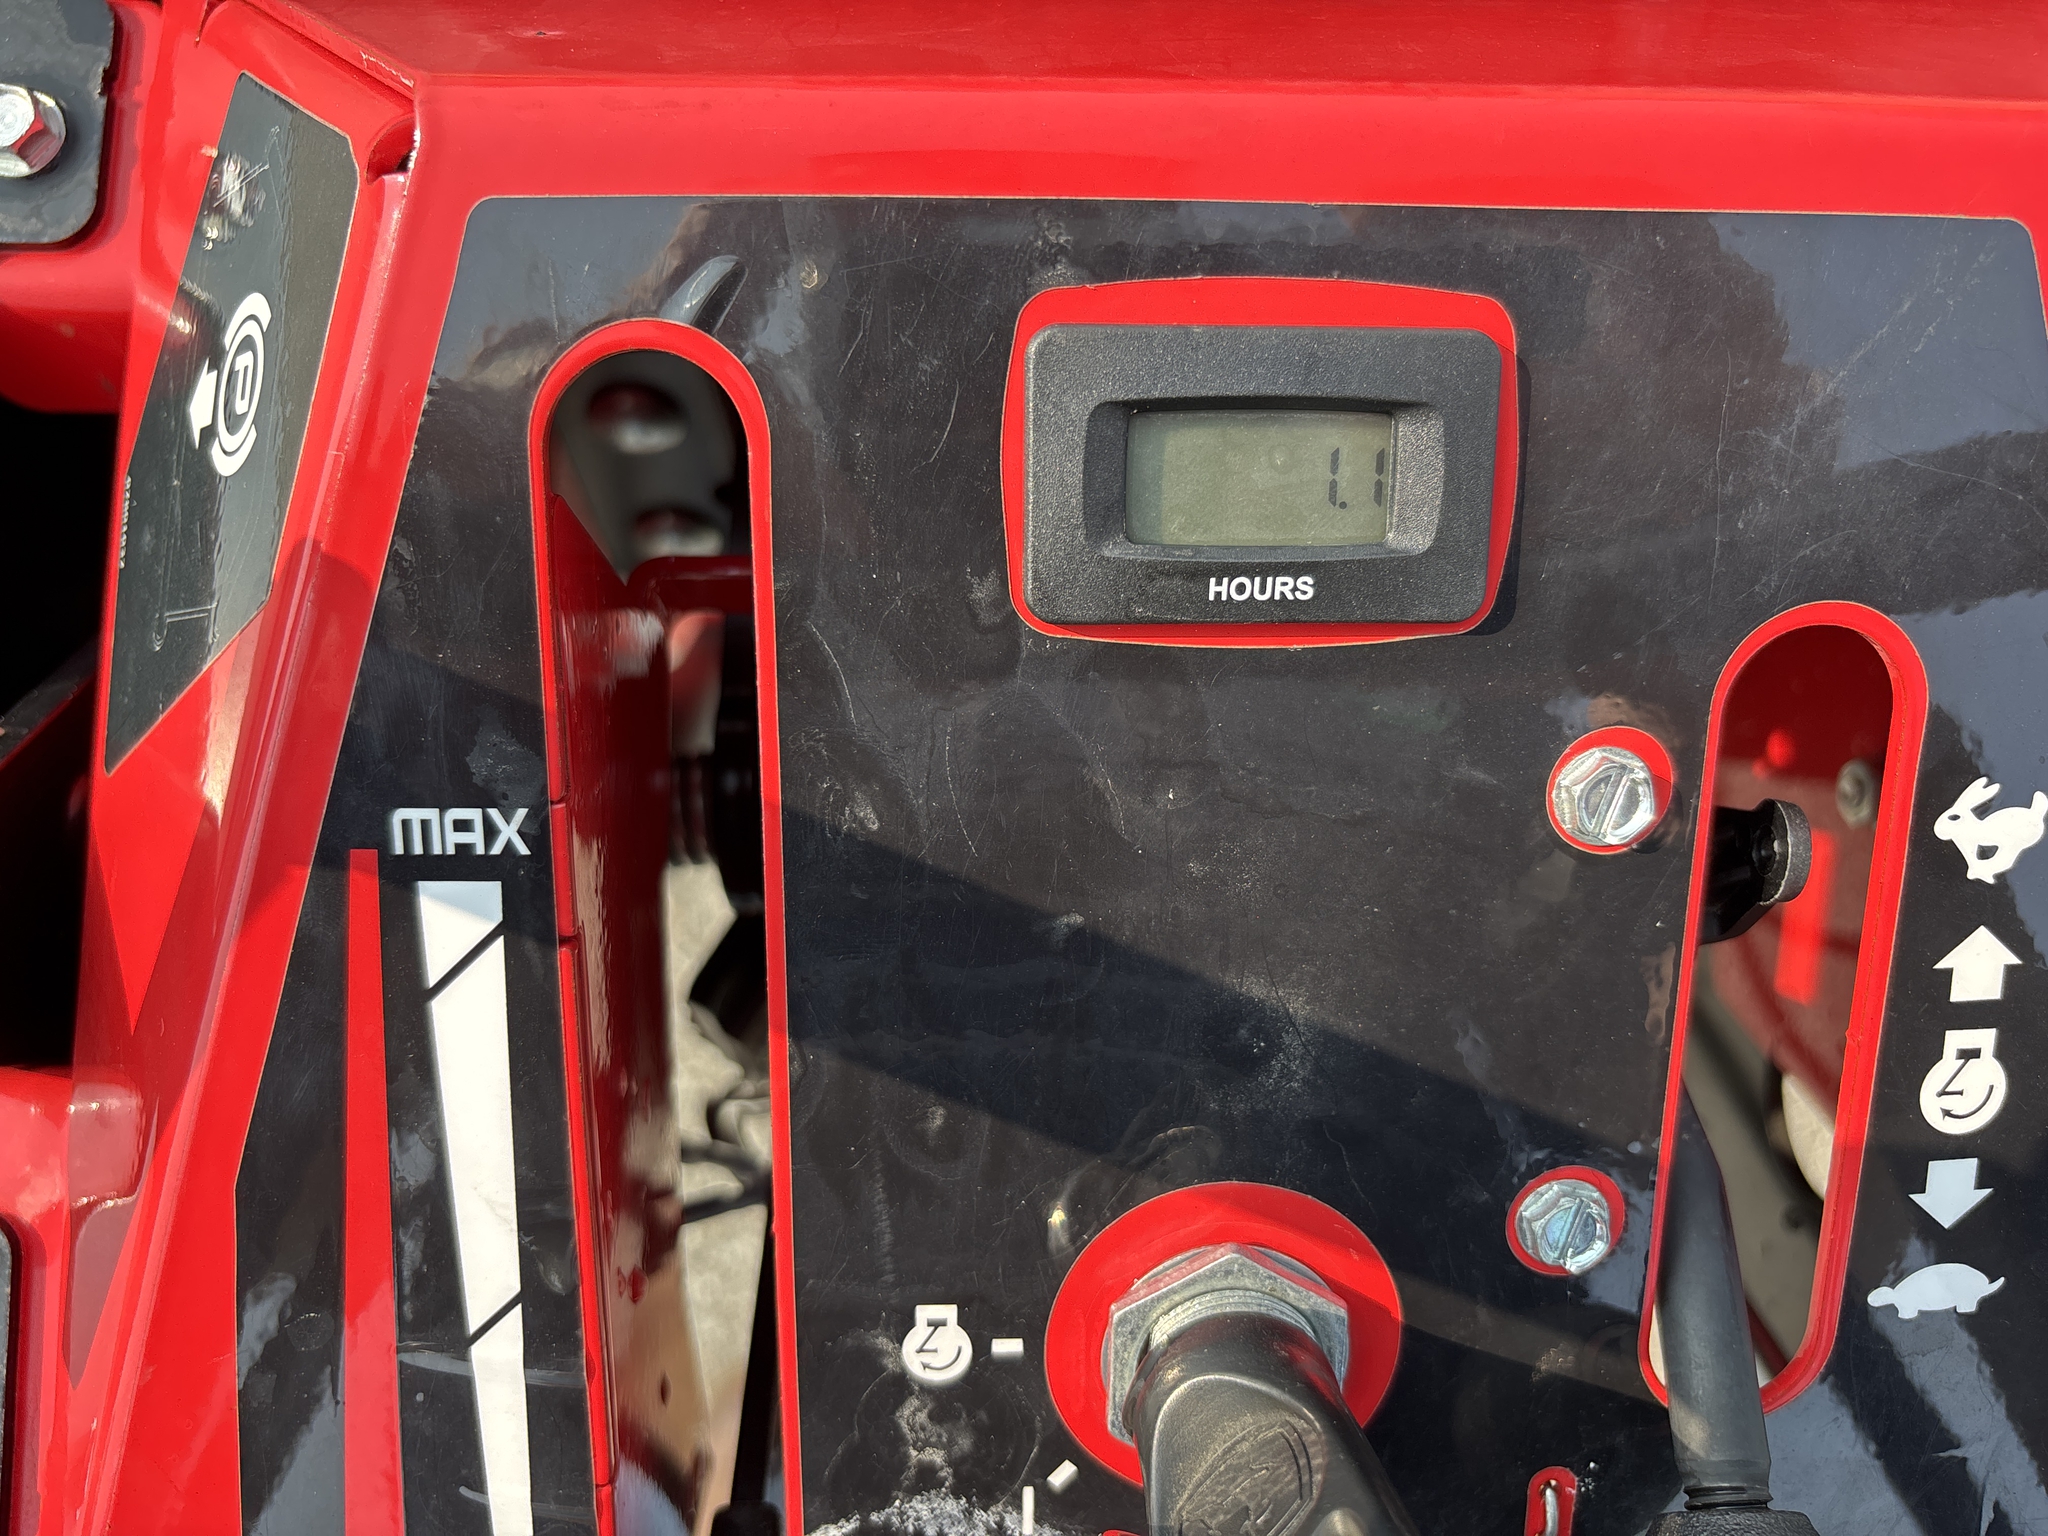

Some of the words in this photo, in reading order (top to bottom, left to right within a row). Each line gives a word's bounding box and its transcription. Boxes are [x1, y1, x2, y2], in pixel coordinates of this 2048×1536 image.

[1328, 447, 1385, 509] 1.1
[1208, 575, 1314, 601] HOURS
[392, 807, 532, 855] MAX
